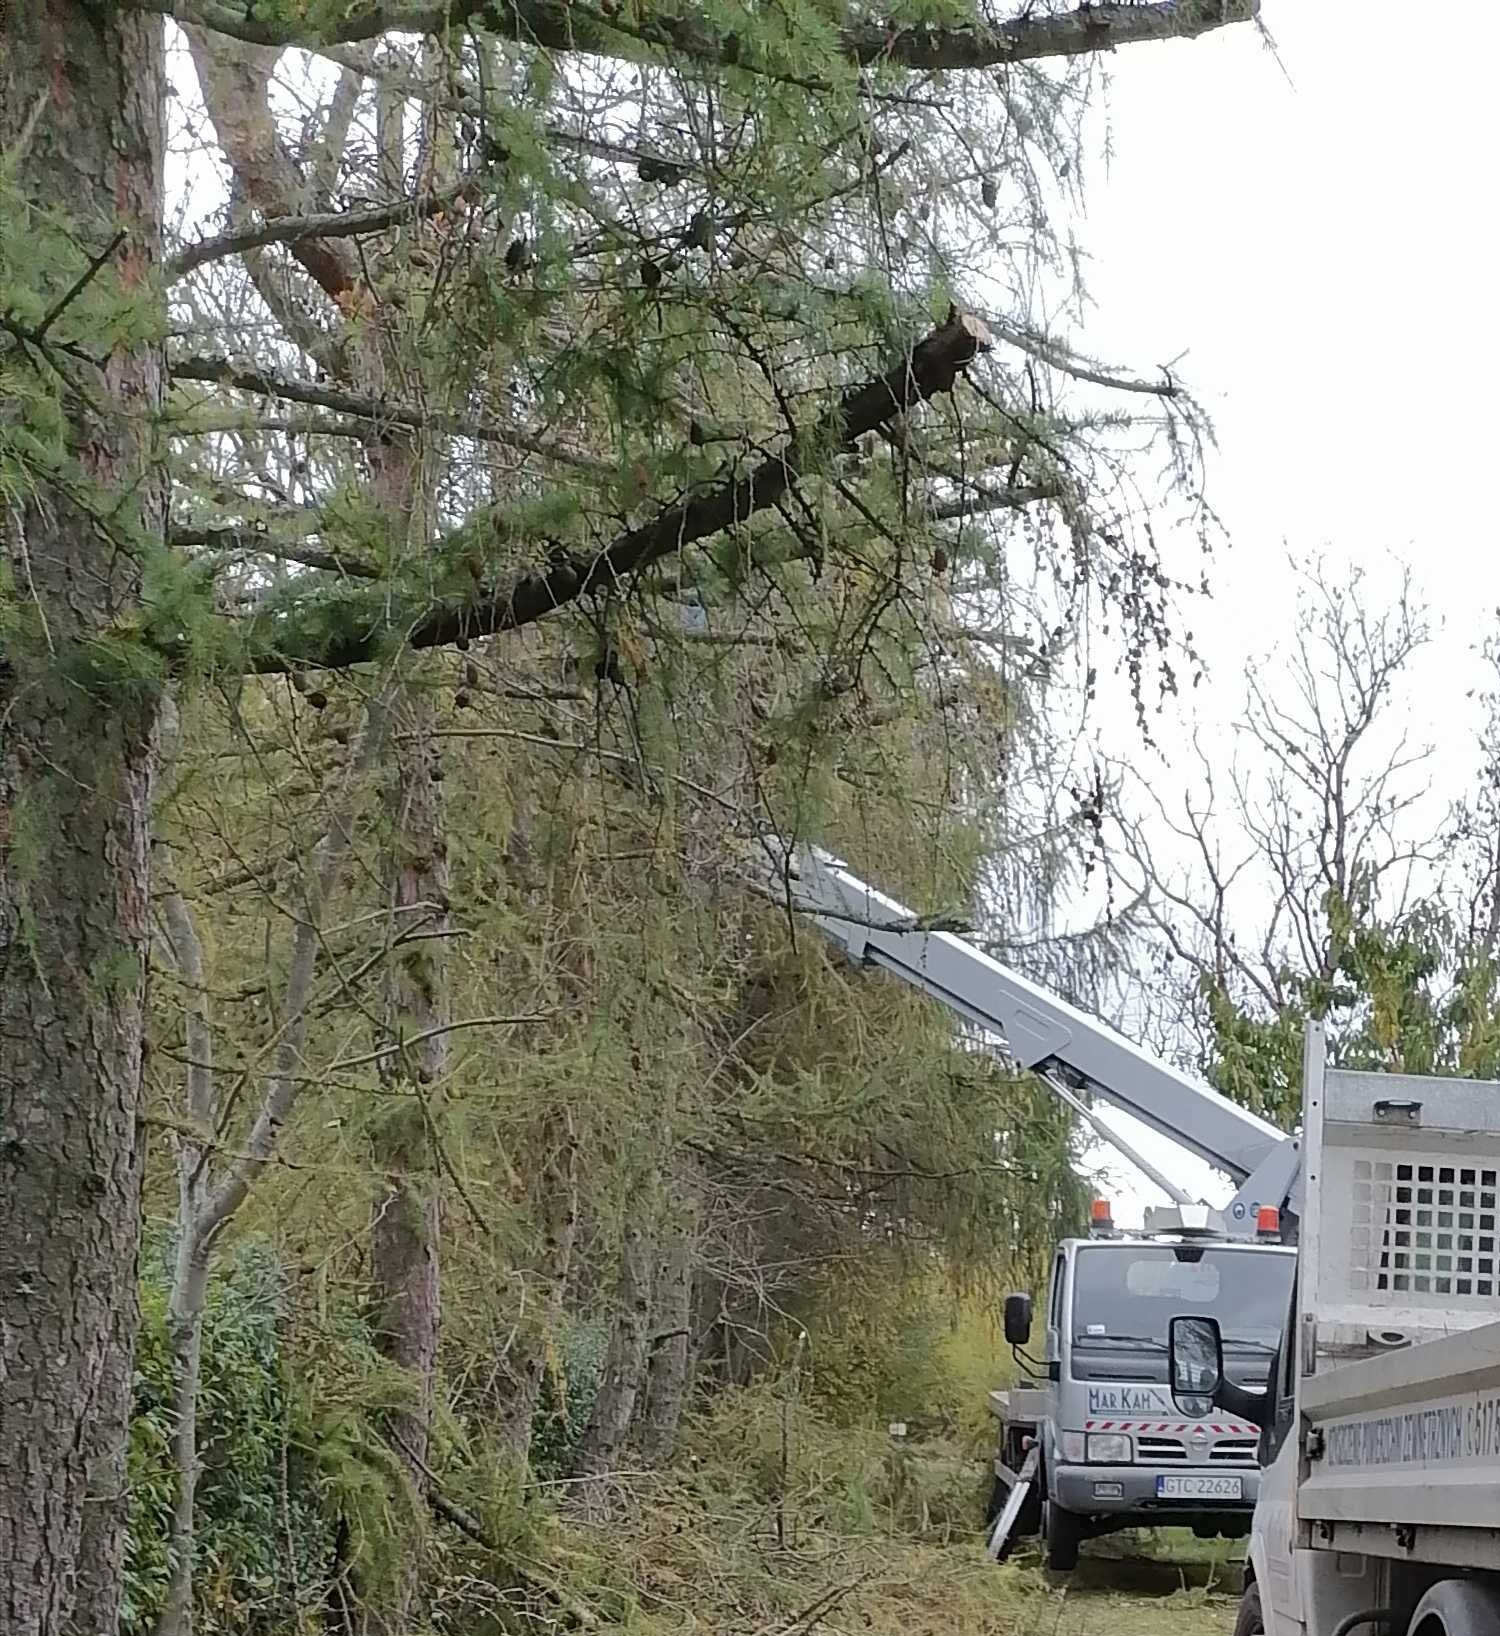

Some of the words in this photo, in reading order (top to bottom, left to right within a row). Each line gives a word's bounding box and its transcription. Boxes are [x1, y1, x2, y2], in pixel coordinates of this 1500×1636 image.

[1474, 1399, 1494, 1456] 517
[1166, 1478, 1193, 1493] GTC
[1197, 1479, 1240, 1495] 22626
